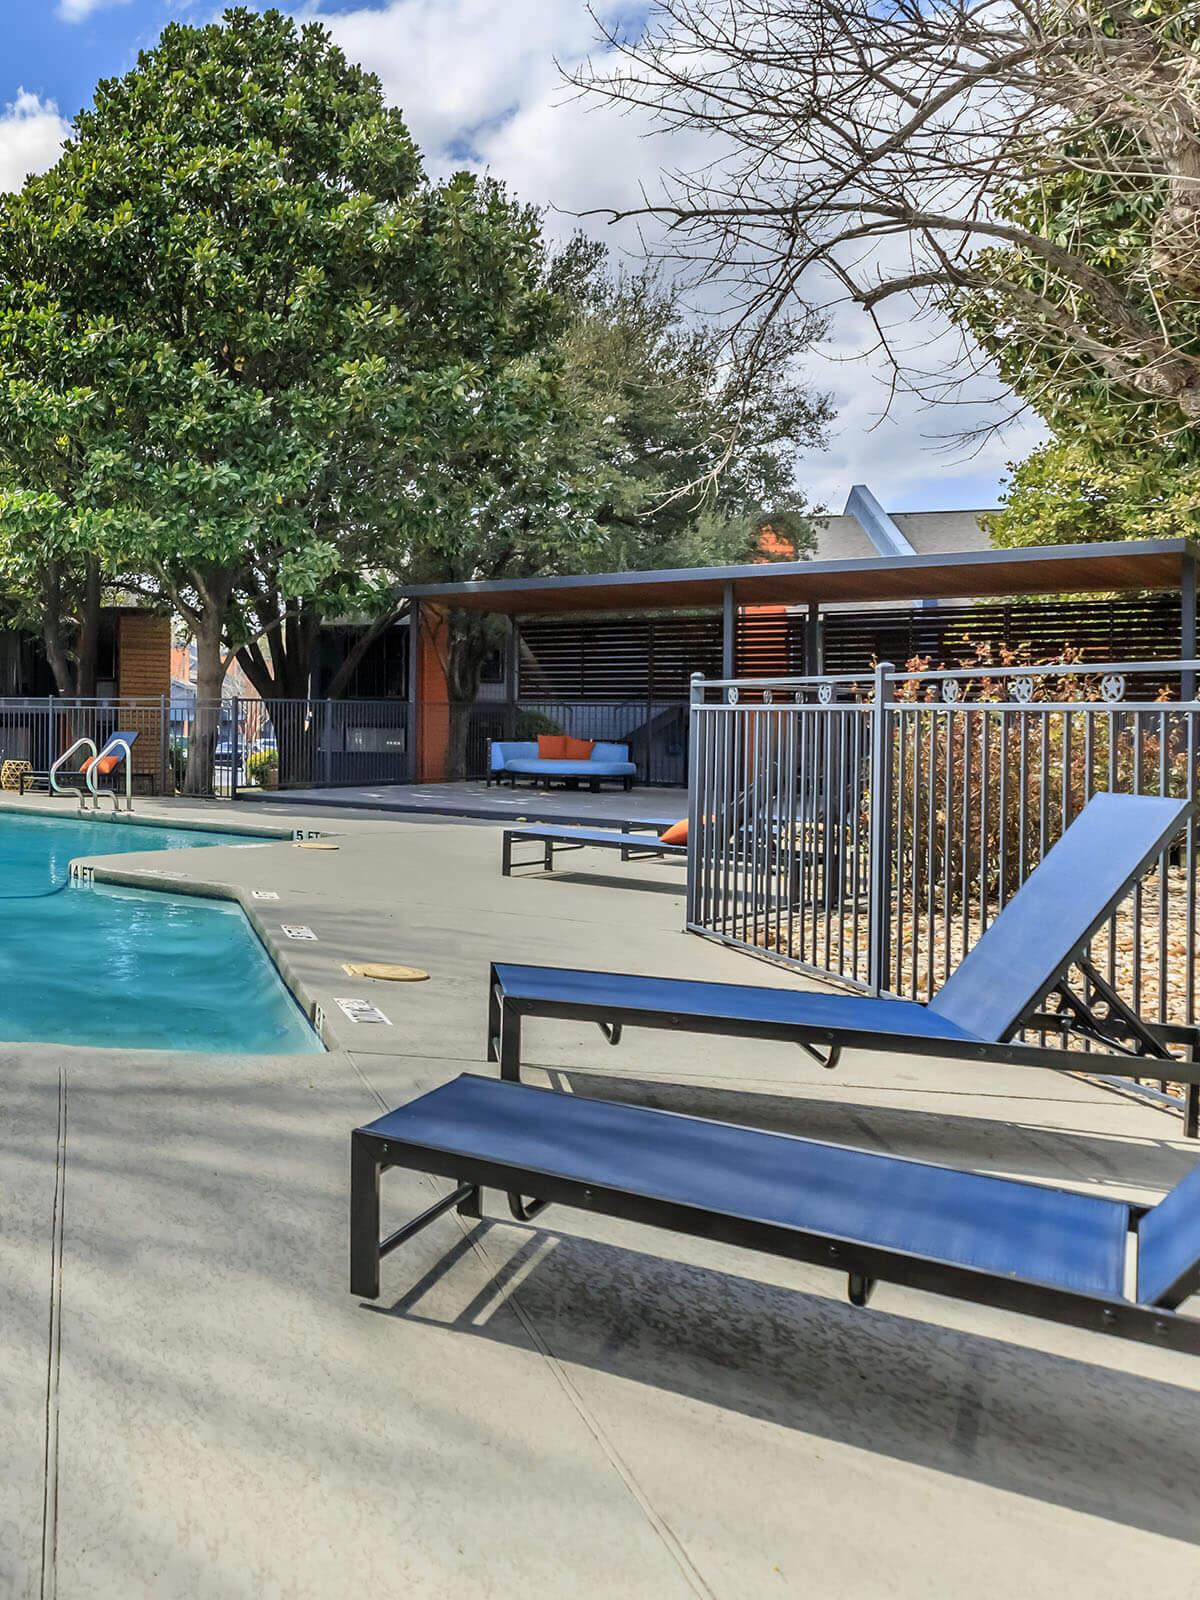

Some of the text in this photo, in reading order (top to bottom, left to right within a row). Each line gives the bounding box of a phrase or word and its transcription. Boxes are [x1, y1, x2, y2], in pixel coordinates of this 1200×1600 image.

[296, 830, 320, 840] 5 FT
[73, 865, 93, 881] 4 FT
